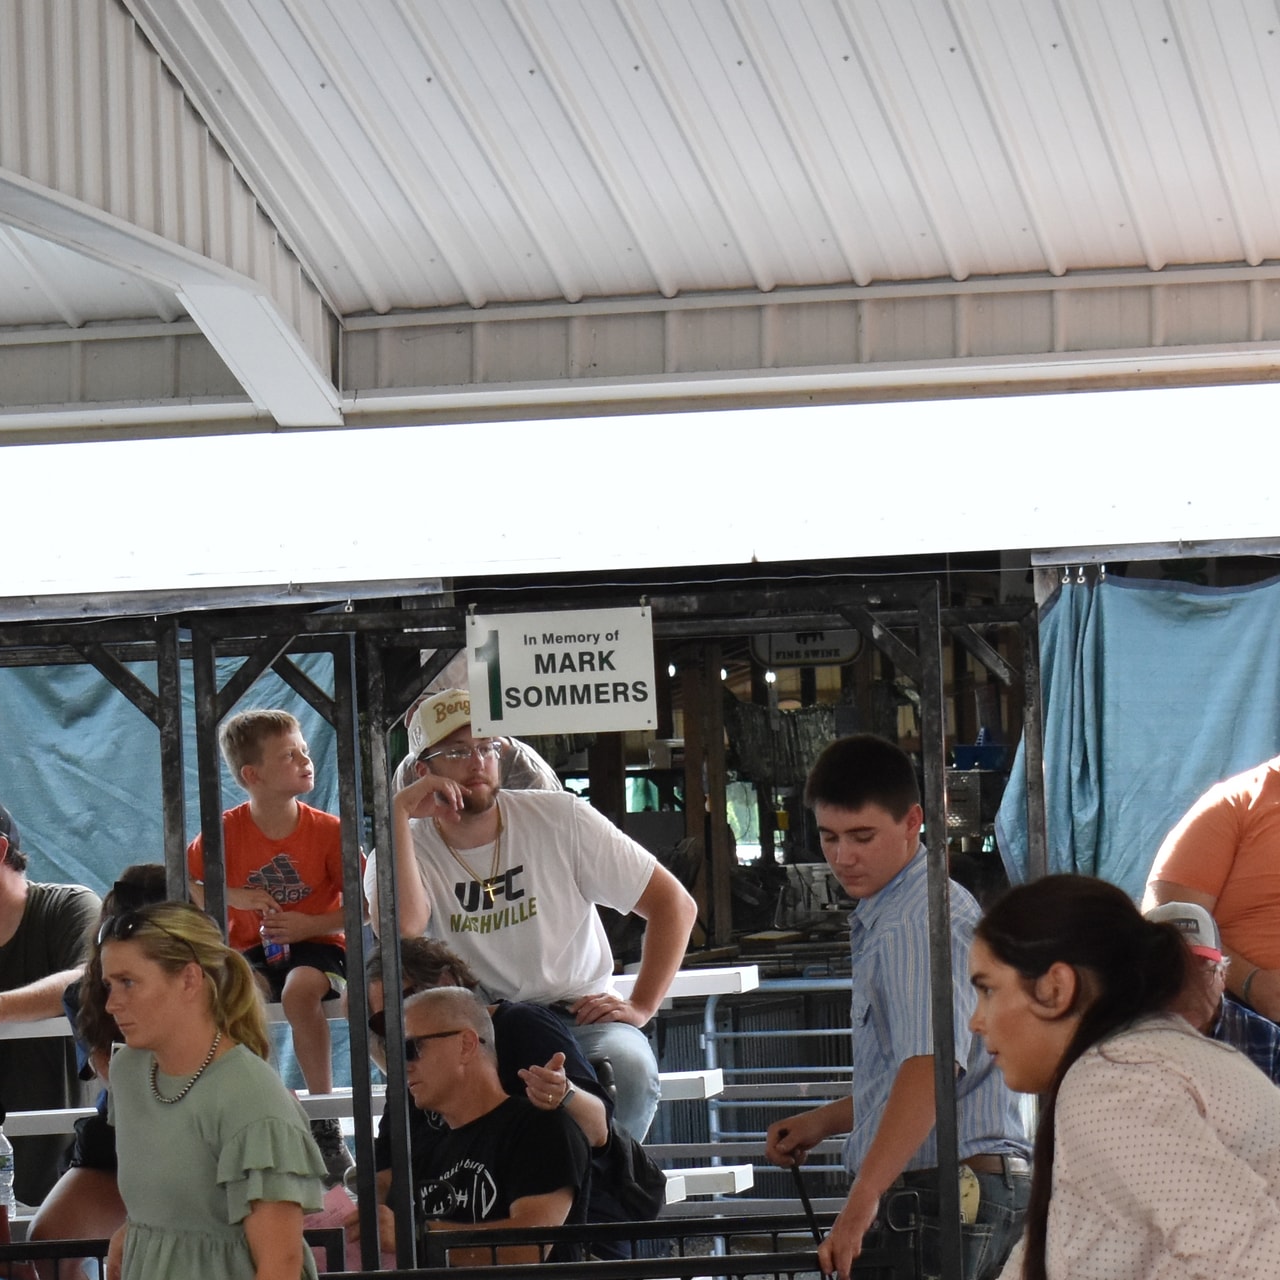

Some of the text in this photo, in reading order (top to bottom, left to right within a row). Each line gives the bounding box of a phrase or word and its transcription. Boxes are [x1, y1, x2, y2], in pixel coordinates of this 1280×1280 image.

[523, 629, 620, 646] In Memory of
[474, 629, 504, 721] 1
[534, 650, 616, 674] MARK
[504, 680, 649, 709] SOMMERS
[454, 865, 525, 913] UFC
[450, 897, 537, 935] NASHVILLE
